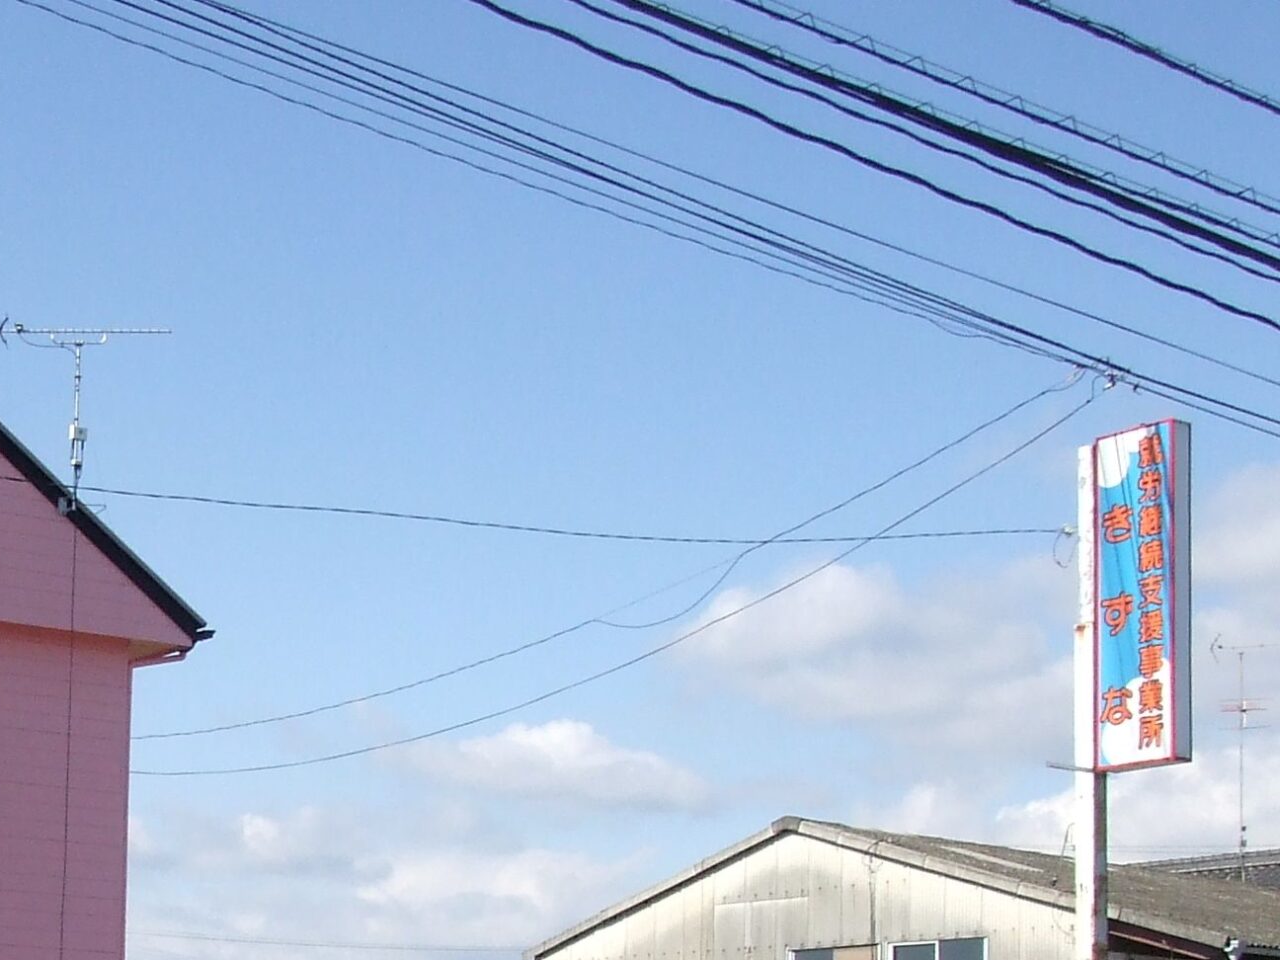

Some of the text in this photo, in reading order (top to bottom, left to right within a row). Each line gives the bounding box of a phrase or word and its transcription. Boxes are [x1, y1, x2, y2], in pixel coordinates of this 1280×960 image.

[1138, 434, 1164, 750] 就労継続支援事業所
